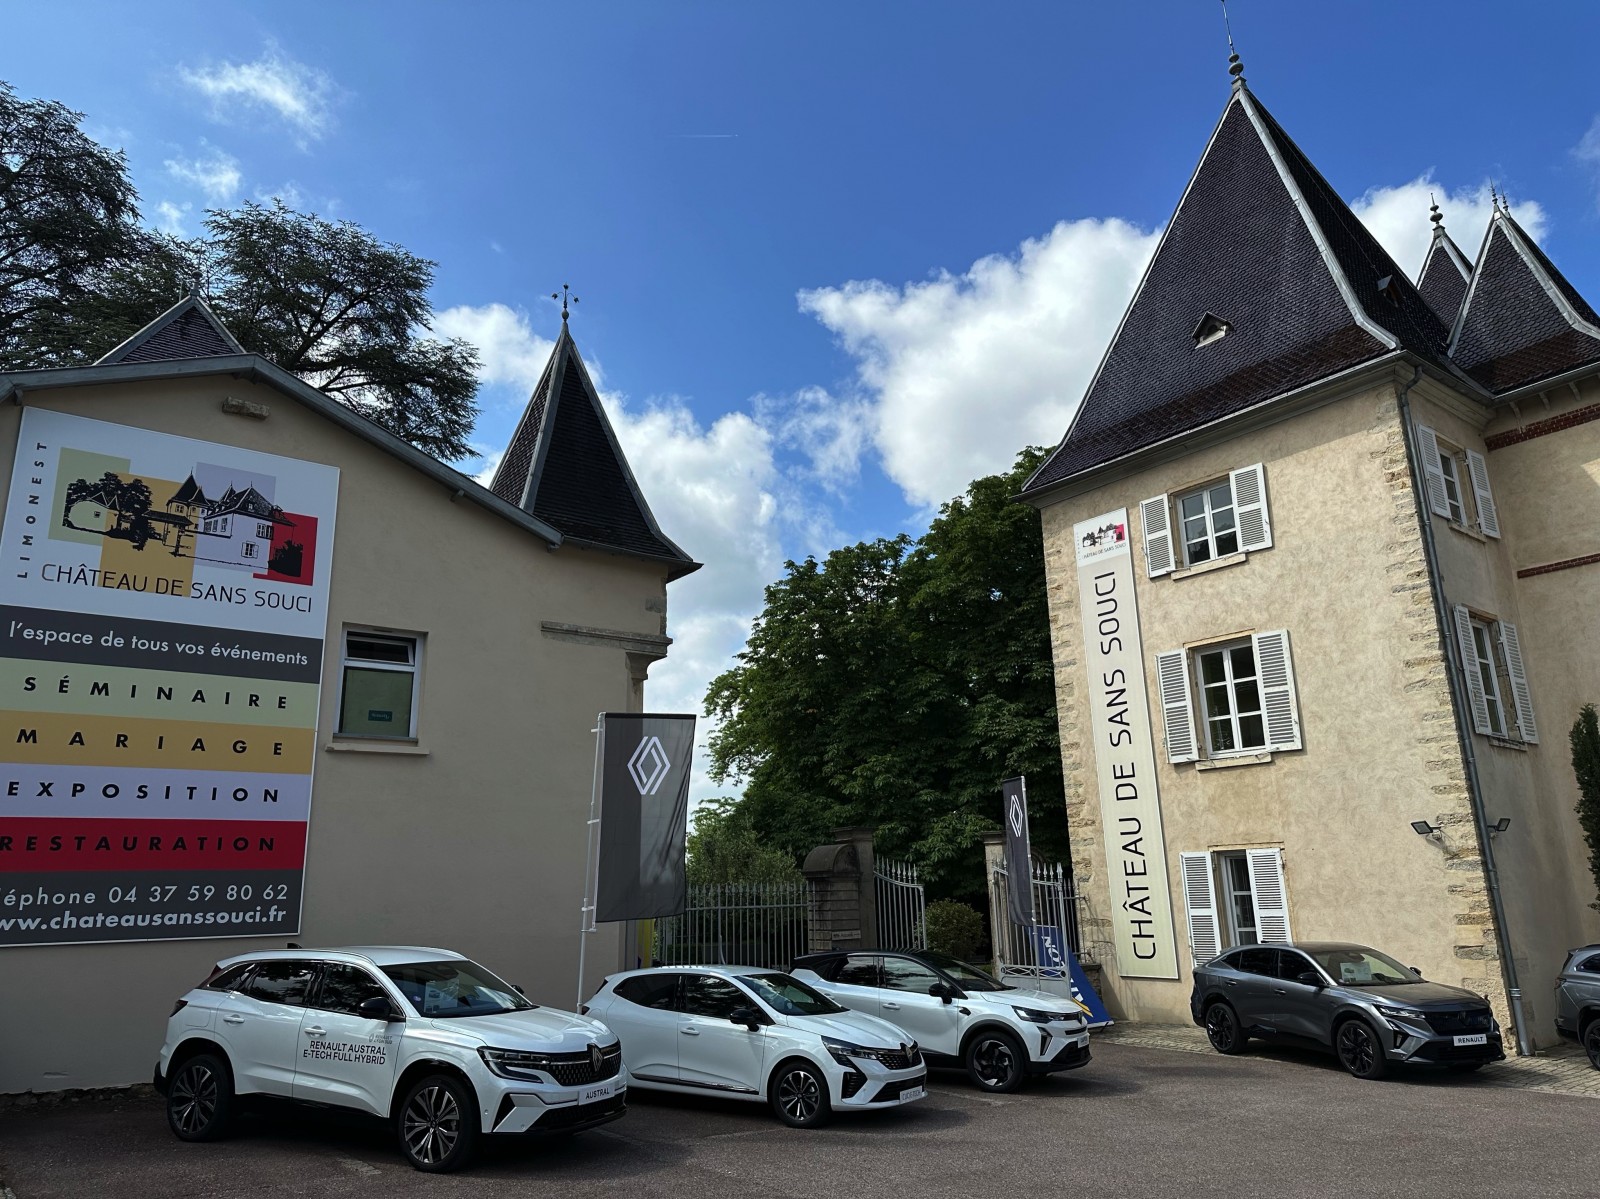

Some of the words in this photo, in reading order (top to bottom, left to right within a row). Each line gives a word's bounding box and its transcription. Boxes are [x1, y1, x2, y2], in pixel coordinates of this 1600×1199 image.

[17, 442, 47, 579] LIMONEST
[41, 563, 149, 593] CHÂTEAU
[155, 577, 183, 597] DE
[191, 582, 247, 605] SANS
[254, 590, 312, 613] SOUCI
[1094, 571, 1122, 655] SOUCI
[100, 631, 125, 649] de
[131, 635, 169, 652] tous
[176, 642, 205, 657] vos
[210, 642, 309, 666] événements
[23, 675, 288, 710] SÉMINAIRE
[1103, 669, 1132, 747] SANS
[16, 728, 283, 756] MARIAGE
[7, 781, 279, 803] EXPOSITION
[1112, 762, 1138, 801] DE
[0, 836, 275, 852] RESTAURATION
[0, 886, 96, 911] éphone
[108, 887, 137, 904] 04
[149, 886, 178, 902] 37
[188, 885, 215, 902] 59
[226, 885, 252, 901] 80
[263, 884, 288, 901] 62
[1118, 817, 1157, 960] CHÂTEAU
[309, 1040, 347, 1052] RENAULT
[347, 1044, 387, 1056] AUSTRAL
[1457, 1036, 1484, 1044] RENAULT
[303, 1049, 332, 1060] E-TECH
[333, 1052, 353, 1062] FULL
[354, 1054, 386, 1065] HYBRID
[585, 1087, 610, 1100] AUSTRAL
